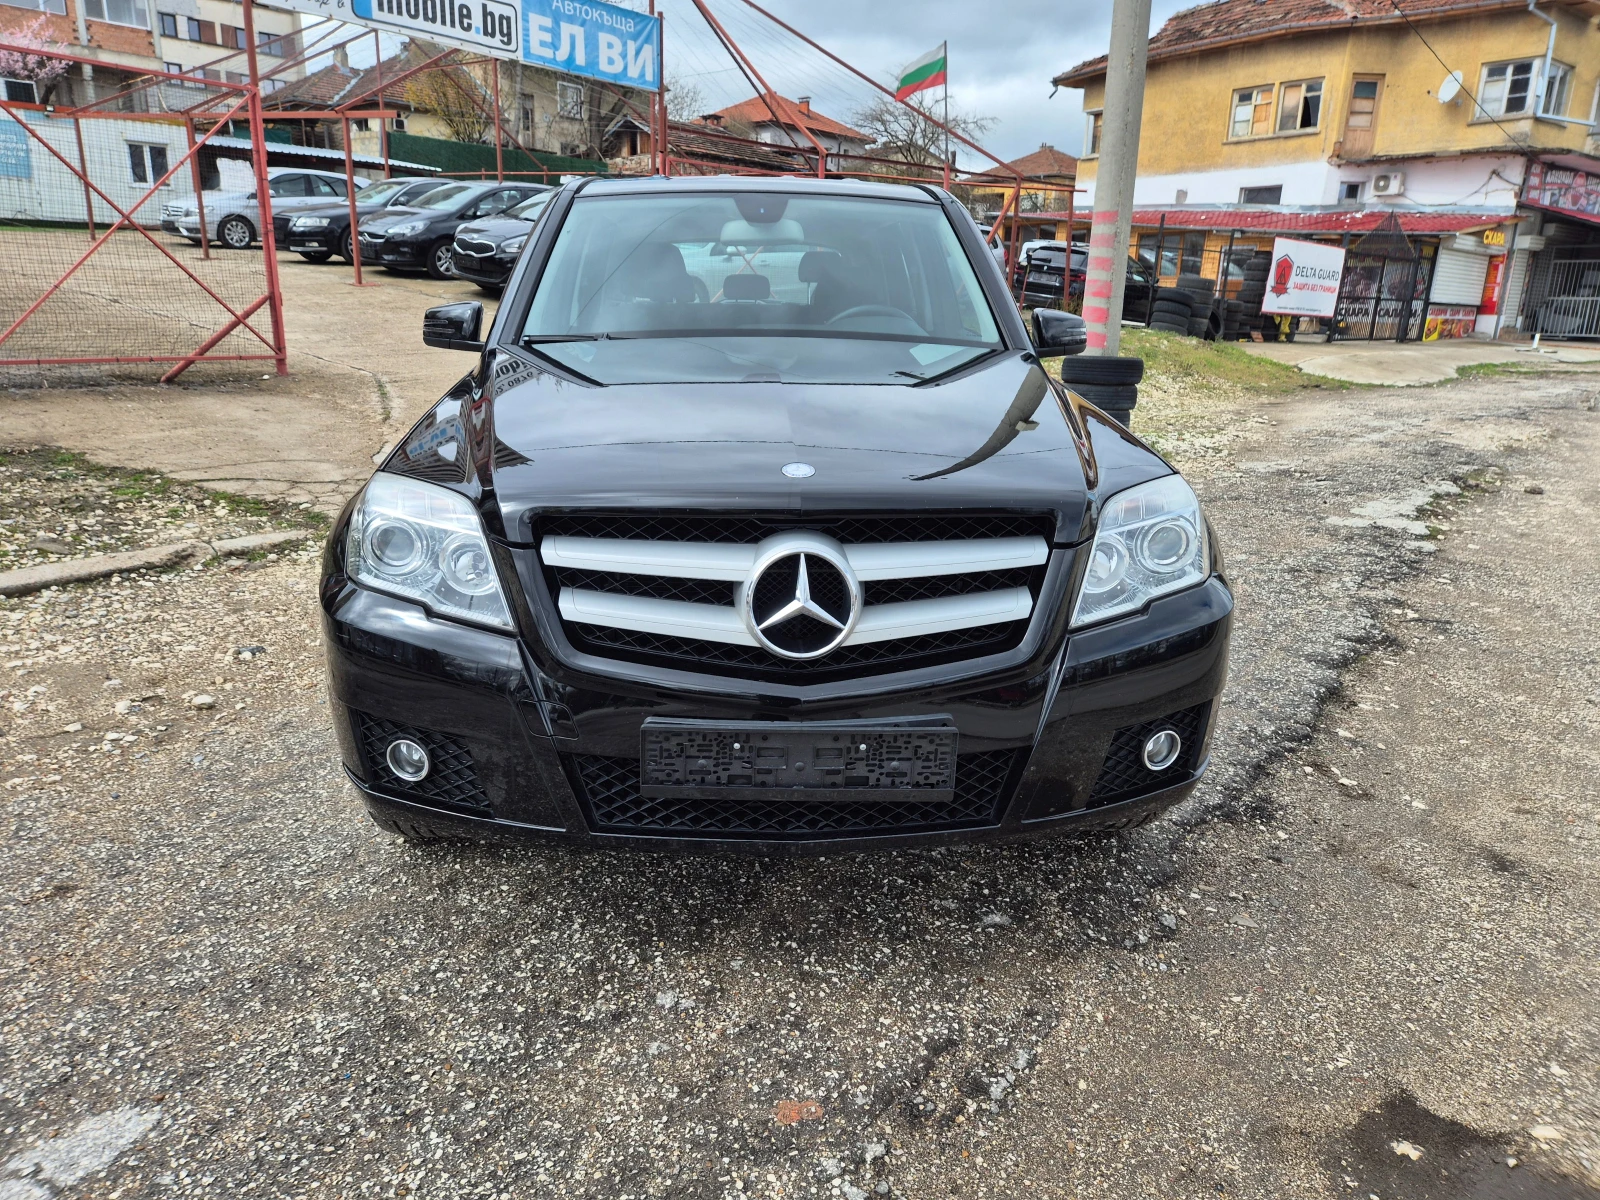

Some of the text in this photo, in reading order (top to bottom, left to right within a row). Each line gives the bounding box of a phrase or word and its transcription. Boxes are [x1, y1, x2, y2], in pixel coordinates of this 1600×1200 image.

[552, 0, 635, 33] Автокъща
[528, 12, 653, 82] ЕЛ ВИ
[1483, 229, 1505, 246] СКАРА
[1295, 265, 1340, 281] DELTA GUARD
